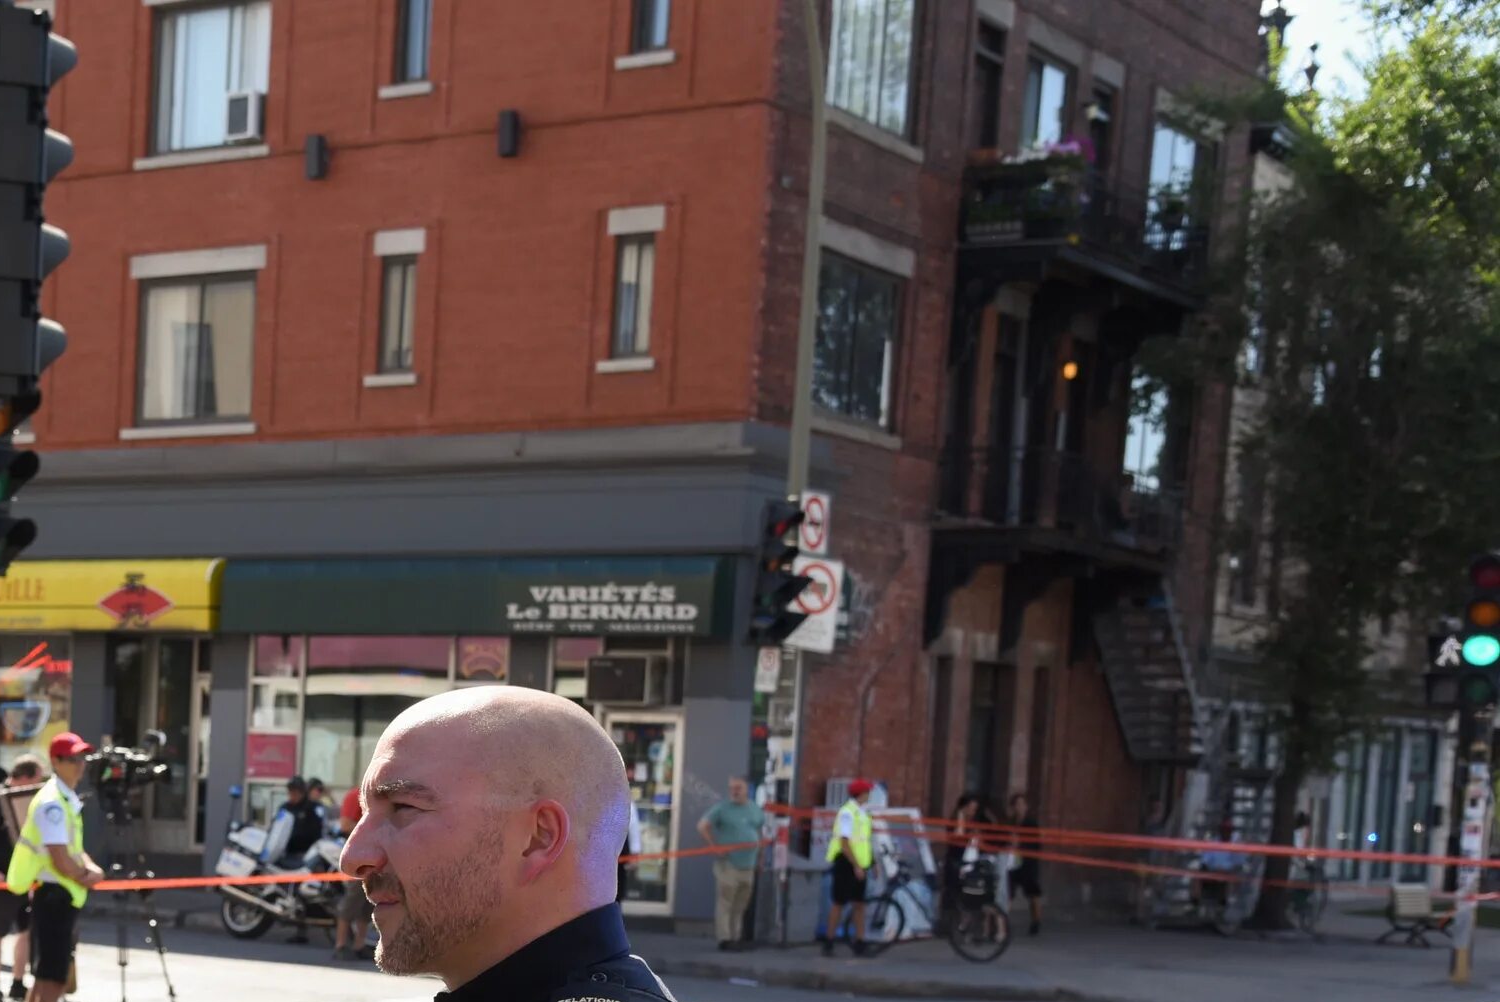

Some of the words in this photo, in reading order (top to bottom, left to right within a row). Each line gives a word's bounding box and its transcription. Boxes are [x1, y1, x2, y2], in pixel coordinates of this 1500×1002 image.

[529, 582, 676, 602] VARIÉTÉS
[506, 603, 541, 620] Le
[548, 603, 698, 621] BERNARD
